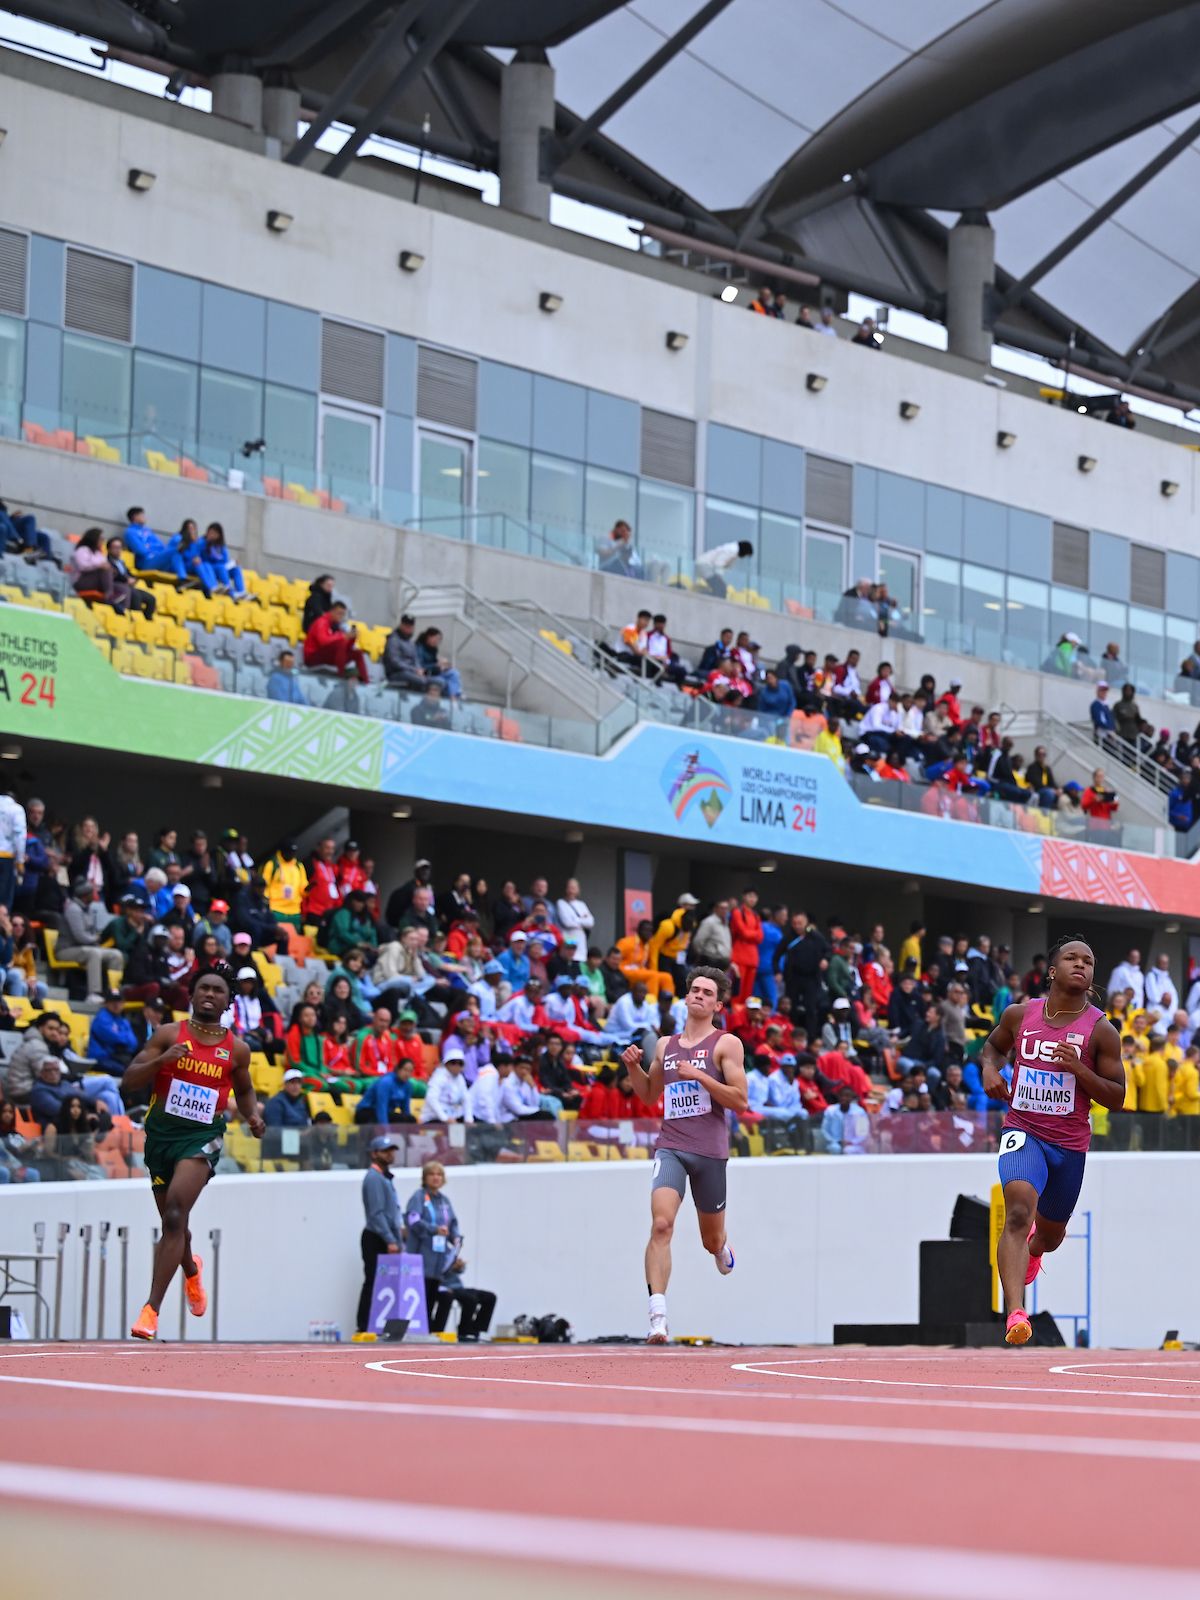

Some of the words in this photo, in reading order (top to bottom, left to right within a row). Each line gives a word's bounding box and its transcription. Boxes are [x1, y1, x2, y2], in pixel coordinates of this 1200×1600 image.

[0, 632, 58, 657] THLETICS
[21, 672, 55, 709] 24
[742, 766, 772, 783] WORLD
[774, 773, 818, 791] ATHLETICS
[740, 795, 786, 828] LIMA
[792, 804, 816, 833] 24
[1021, 1038, 1082, 1063] US
[177, 1057, 223, 1079] GUYANA
[664, 1059, 707, 1071] CADA
[669, 1081, 699, 1094] NTN
[1025, 1069, 1064, 1088] NTN
[179, 1083, 211, 1100] NTN
[1018, 1084, 1071, 1103] WILLIAMS
[171, 1094, 212, 1114] CLARKE
[672, 1095, 699, 1109] RUDE
[1032, 1103, 1053, 1112] LIMA
[181, 1110, 198, 1118] LIMA
[1006, 1134, 1016, 1149] 6
